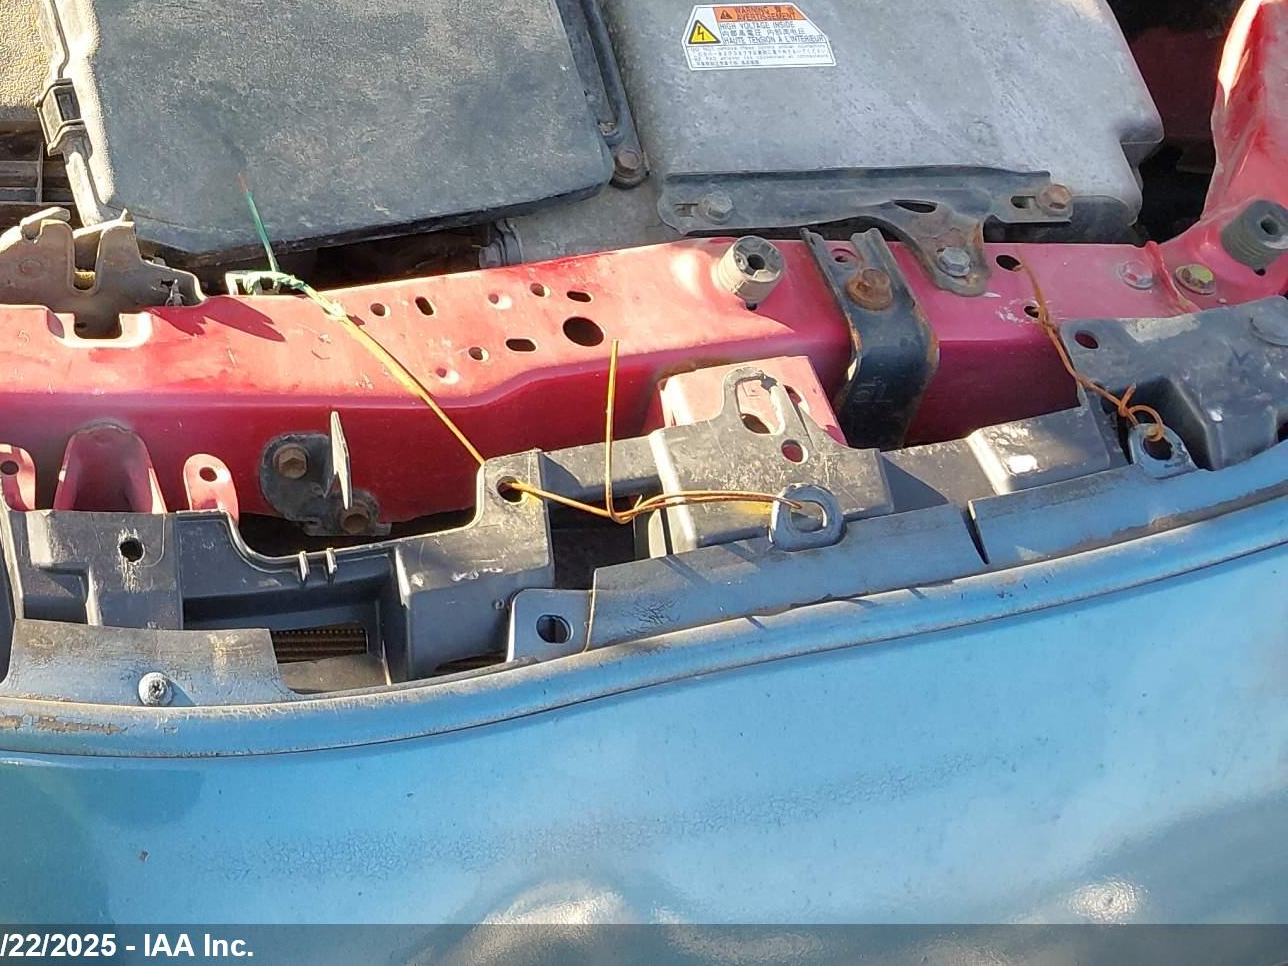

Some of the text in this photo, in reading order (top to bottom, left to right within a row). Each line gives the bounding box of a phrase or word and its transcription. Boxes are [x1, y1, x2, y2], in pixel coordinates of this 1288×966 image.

[720, 22, 737, 30] HIGH
[773, 21, 795, 29] INSIDE
[723, 36, 747, 45] HAUTE
[748, 36, 777, 44] TENSION
